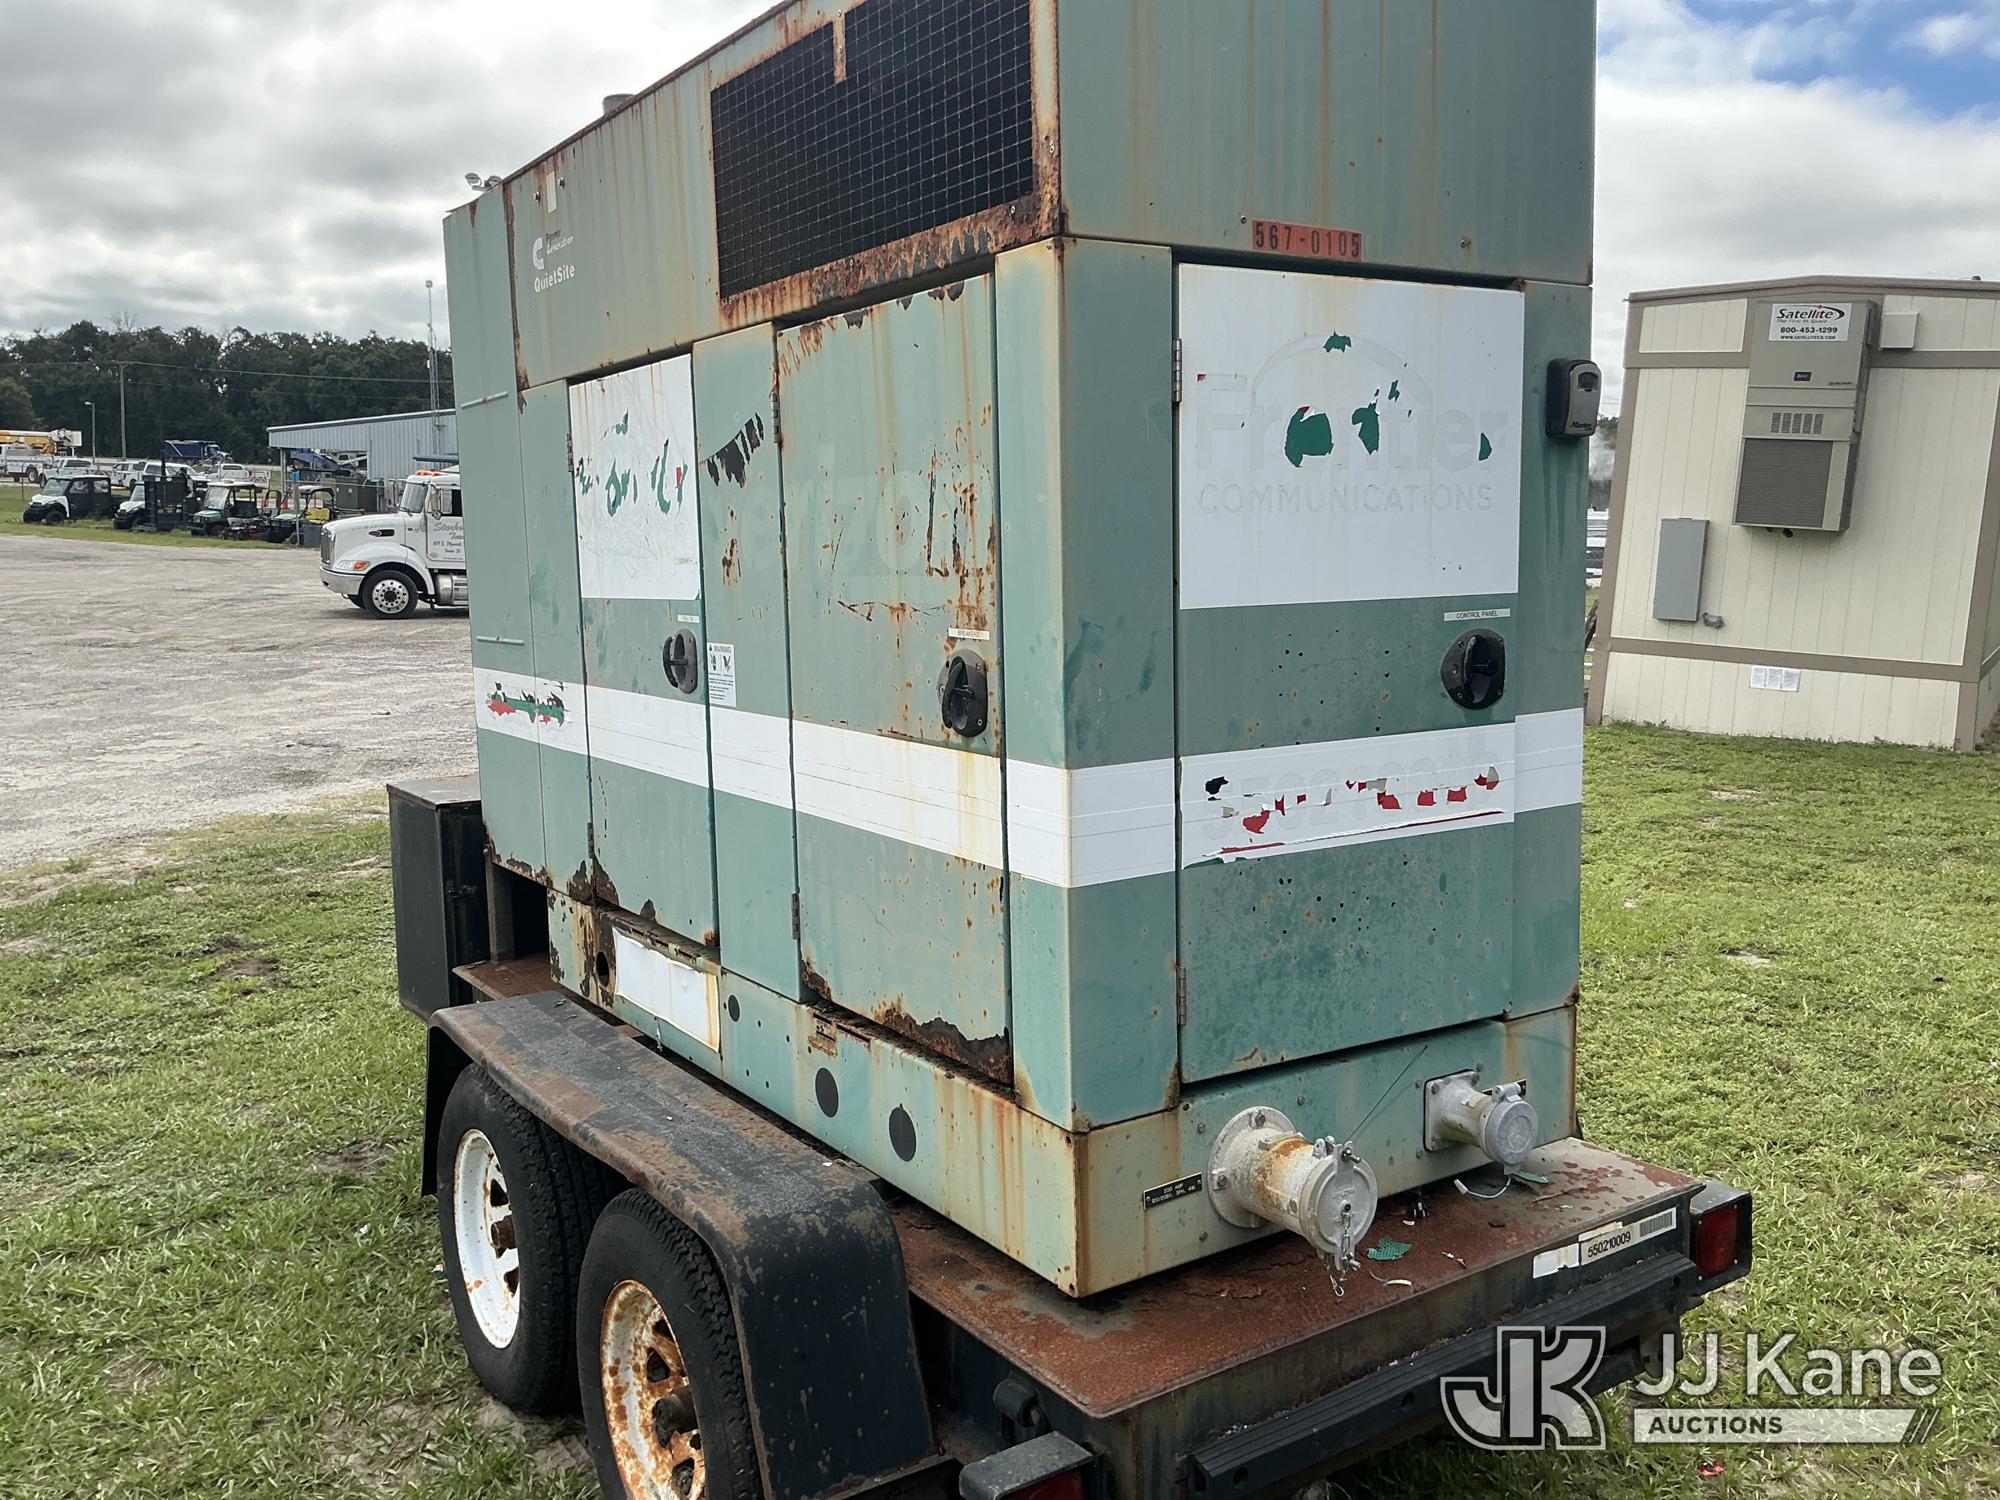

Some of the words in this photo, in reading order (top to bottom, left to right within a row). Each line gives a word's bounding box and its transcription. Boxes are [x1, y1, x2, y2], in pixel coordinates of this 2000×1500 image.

[1255, 222, 1360, 258] 567-0105
[534, 264, 576, 293] QuietSite
[1776, 307, 1834, 319] Satellite
[1196, 373, 1508, 471] Frtier
[1198, 483, 1493, 514] COMMUNICATIONS
[1456, 610, 1480, 619] CONTROL
[1587, 1230, 1631, 1258] 550210009
